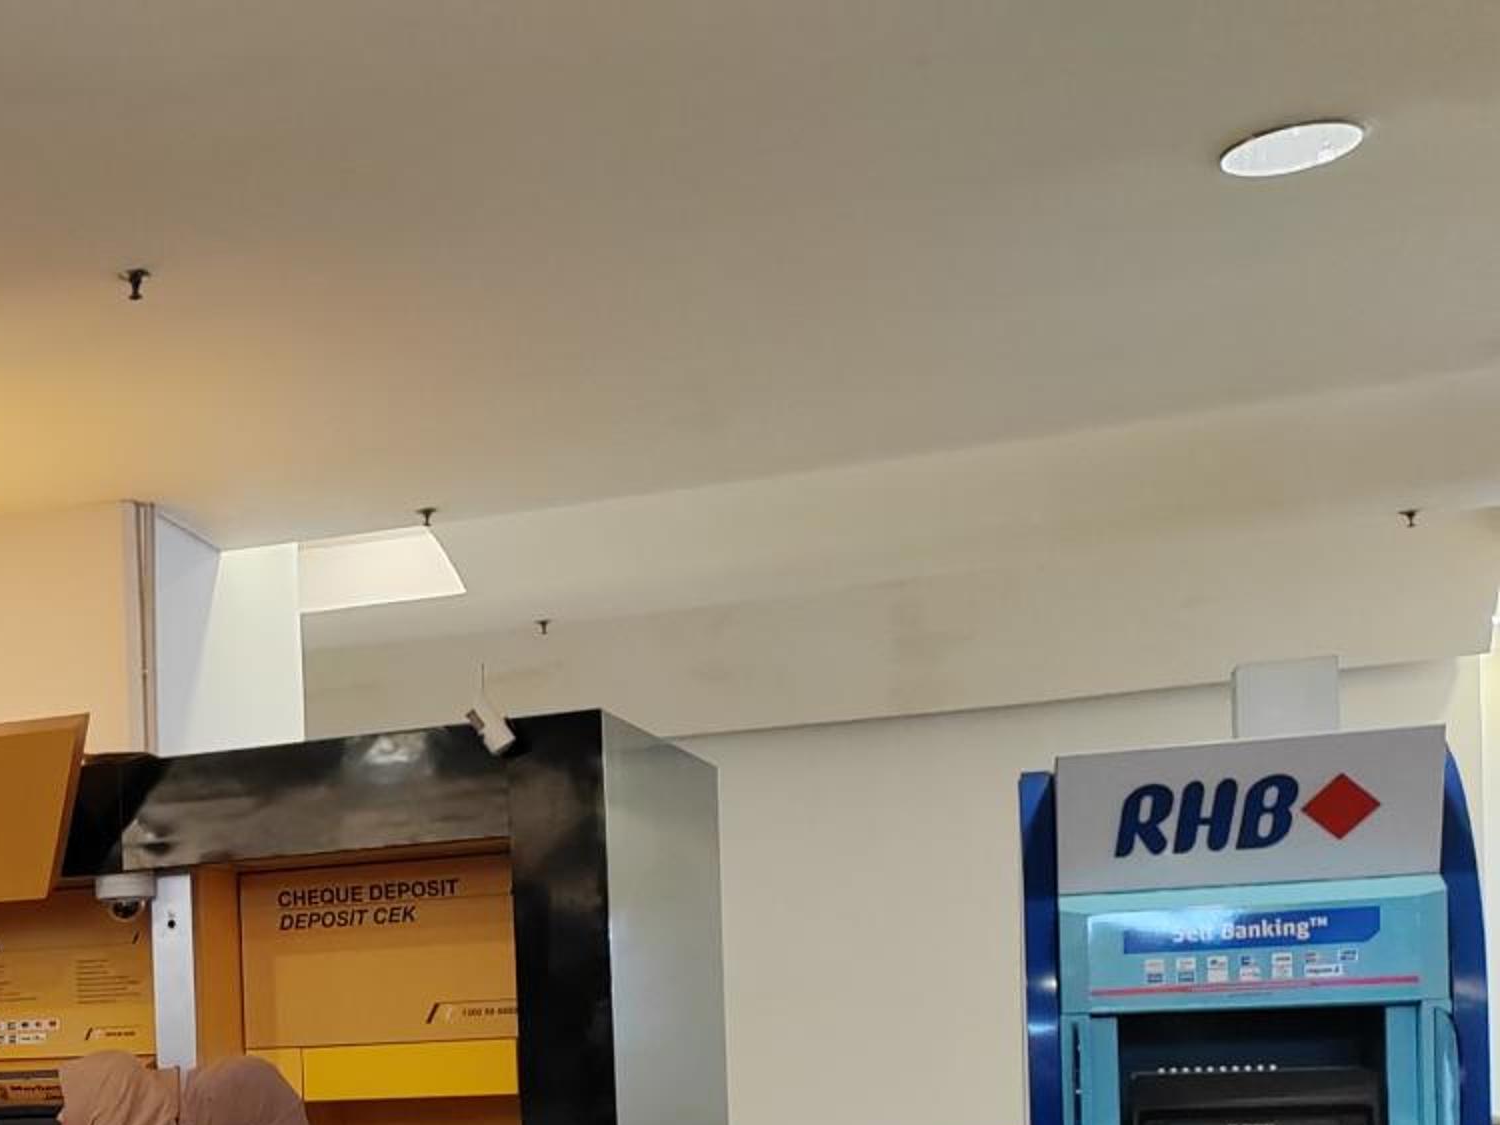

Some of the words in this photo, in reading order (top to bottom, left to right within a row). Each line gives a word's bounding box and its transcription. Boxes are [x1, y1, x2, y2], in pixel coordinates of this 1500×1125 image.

[1114, 774, 1299, 858] RHB
[277, 884, 363, 907] CHEQUE
[368, 878, 459, 901] DEPOSIT
[279, 909, 368, 931] DEPOSIT
[373, 906, 417, 924] CEK
